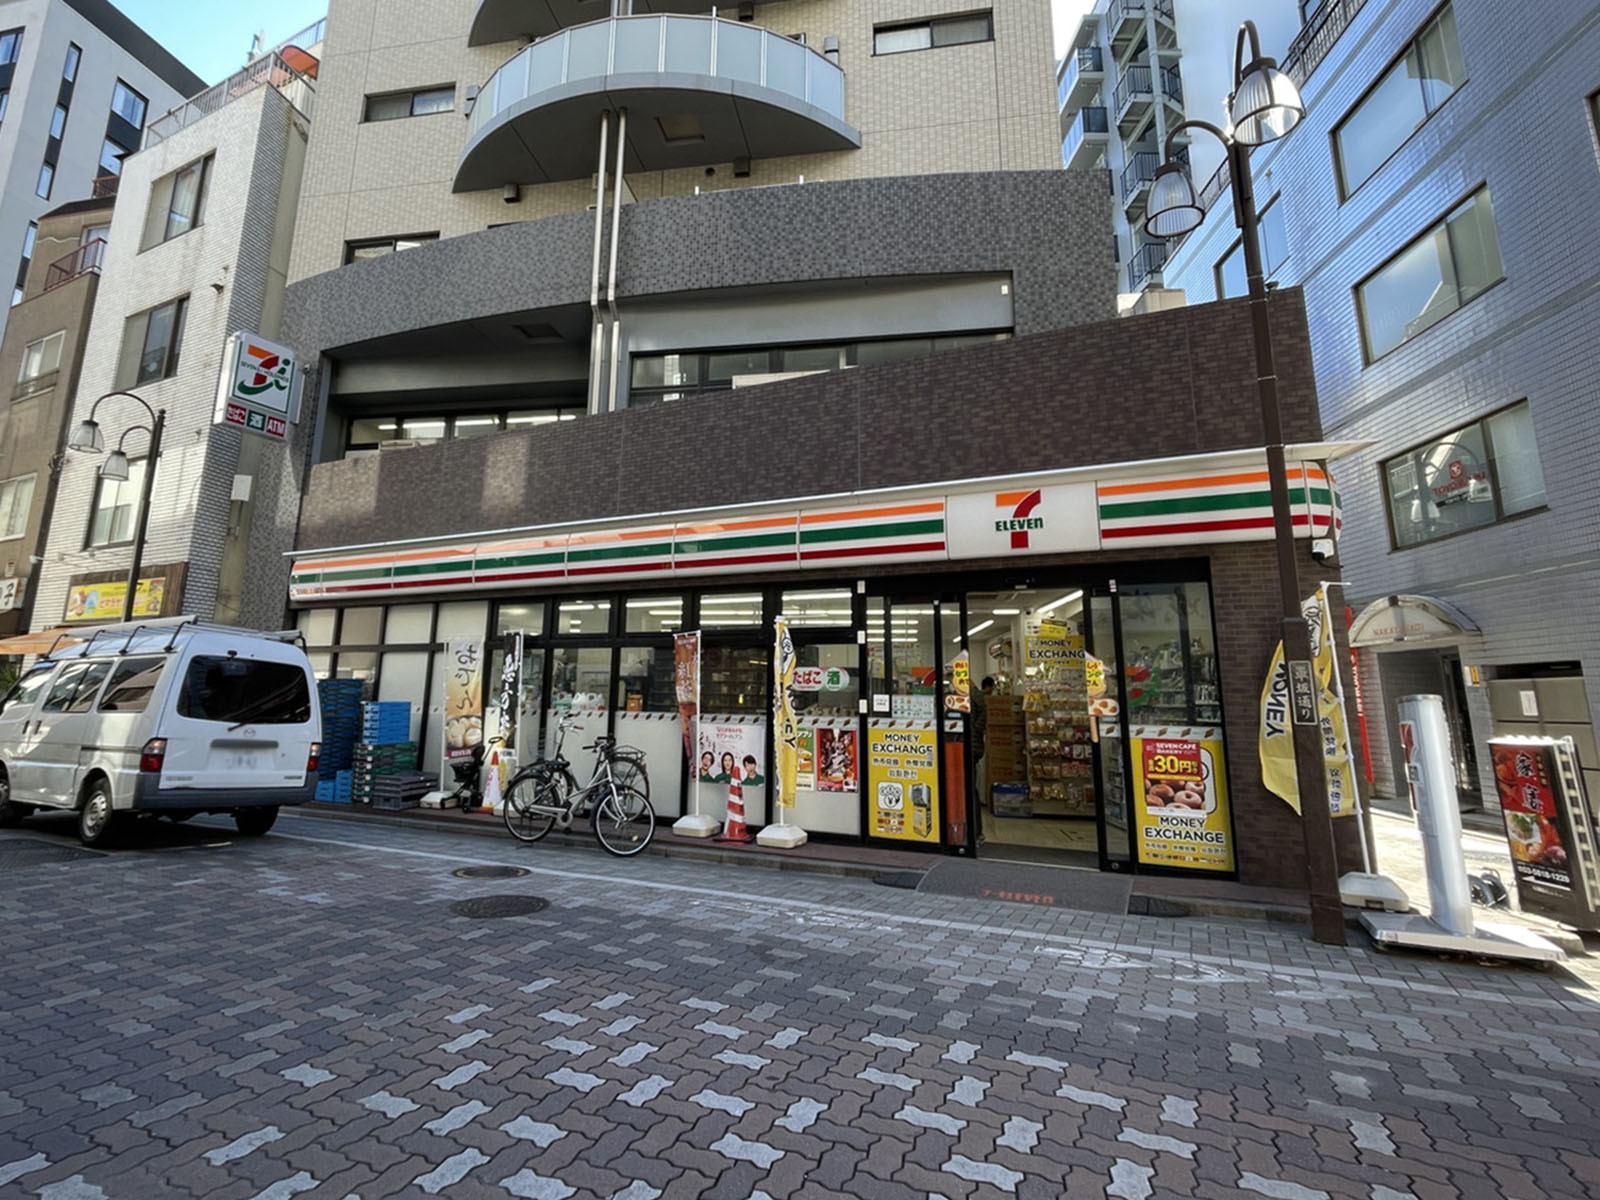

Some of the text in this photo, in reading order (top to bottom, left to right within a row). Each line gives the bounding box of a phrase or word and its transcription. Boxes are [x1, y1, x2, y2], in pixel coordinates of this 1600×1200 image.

[268, 419, 285, 434] ATM
[1029, 649, 1085, 659] EXCHANG
[792, 671, 822, 684] たばこ
[827, 671, 840, 685] 酒
[885, 733, 920, 742] MONEY
[1160, 817, 1205, 828] MONEY
[1145, 828, 1224, 843] EXCHANGE
